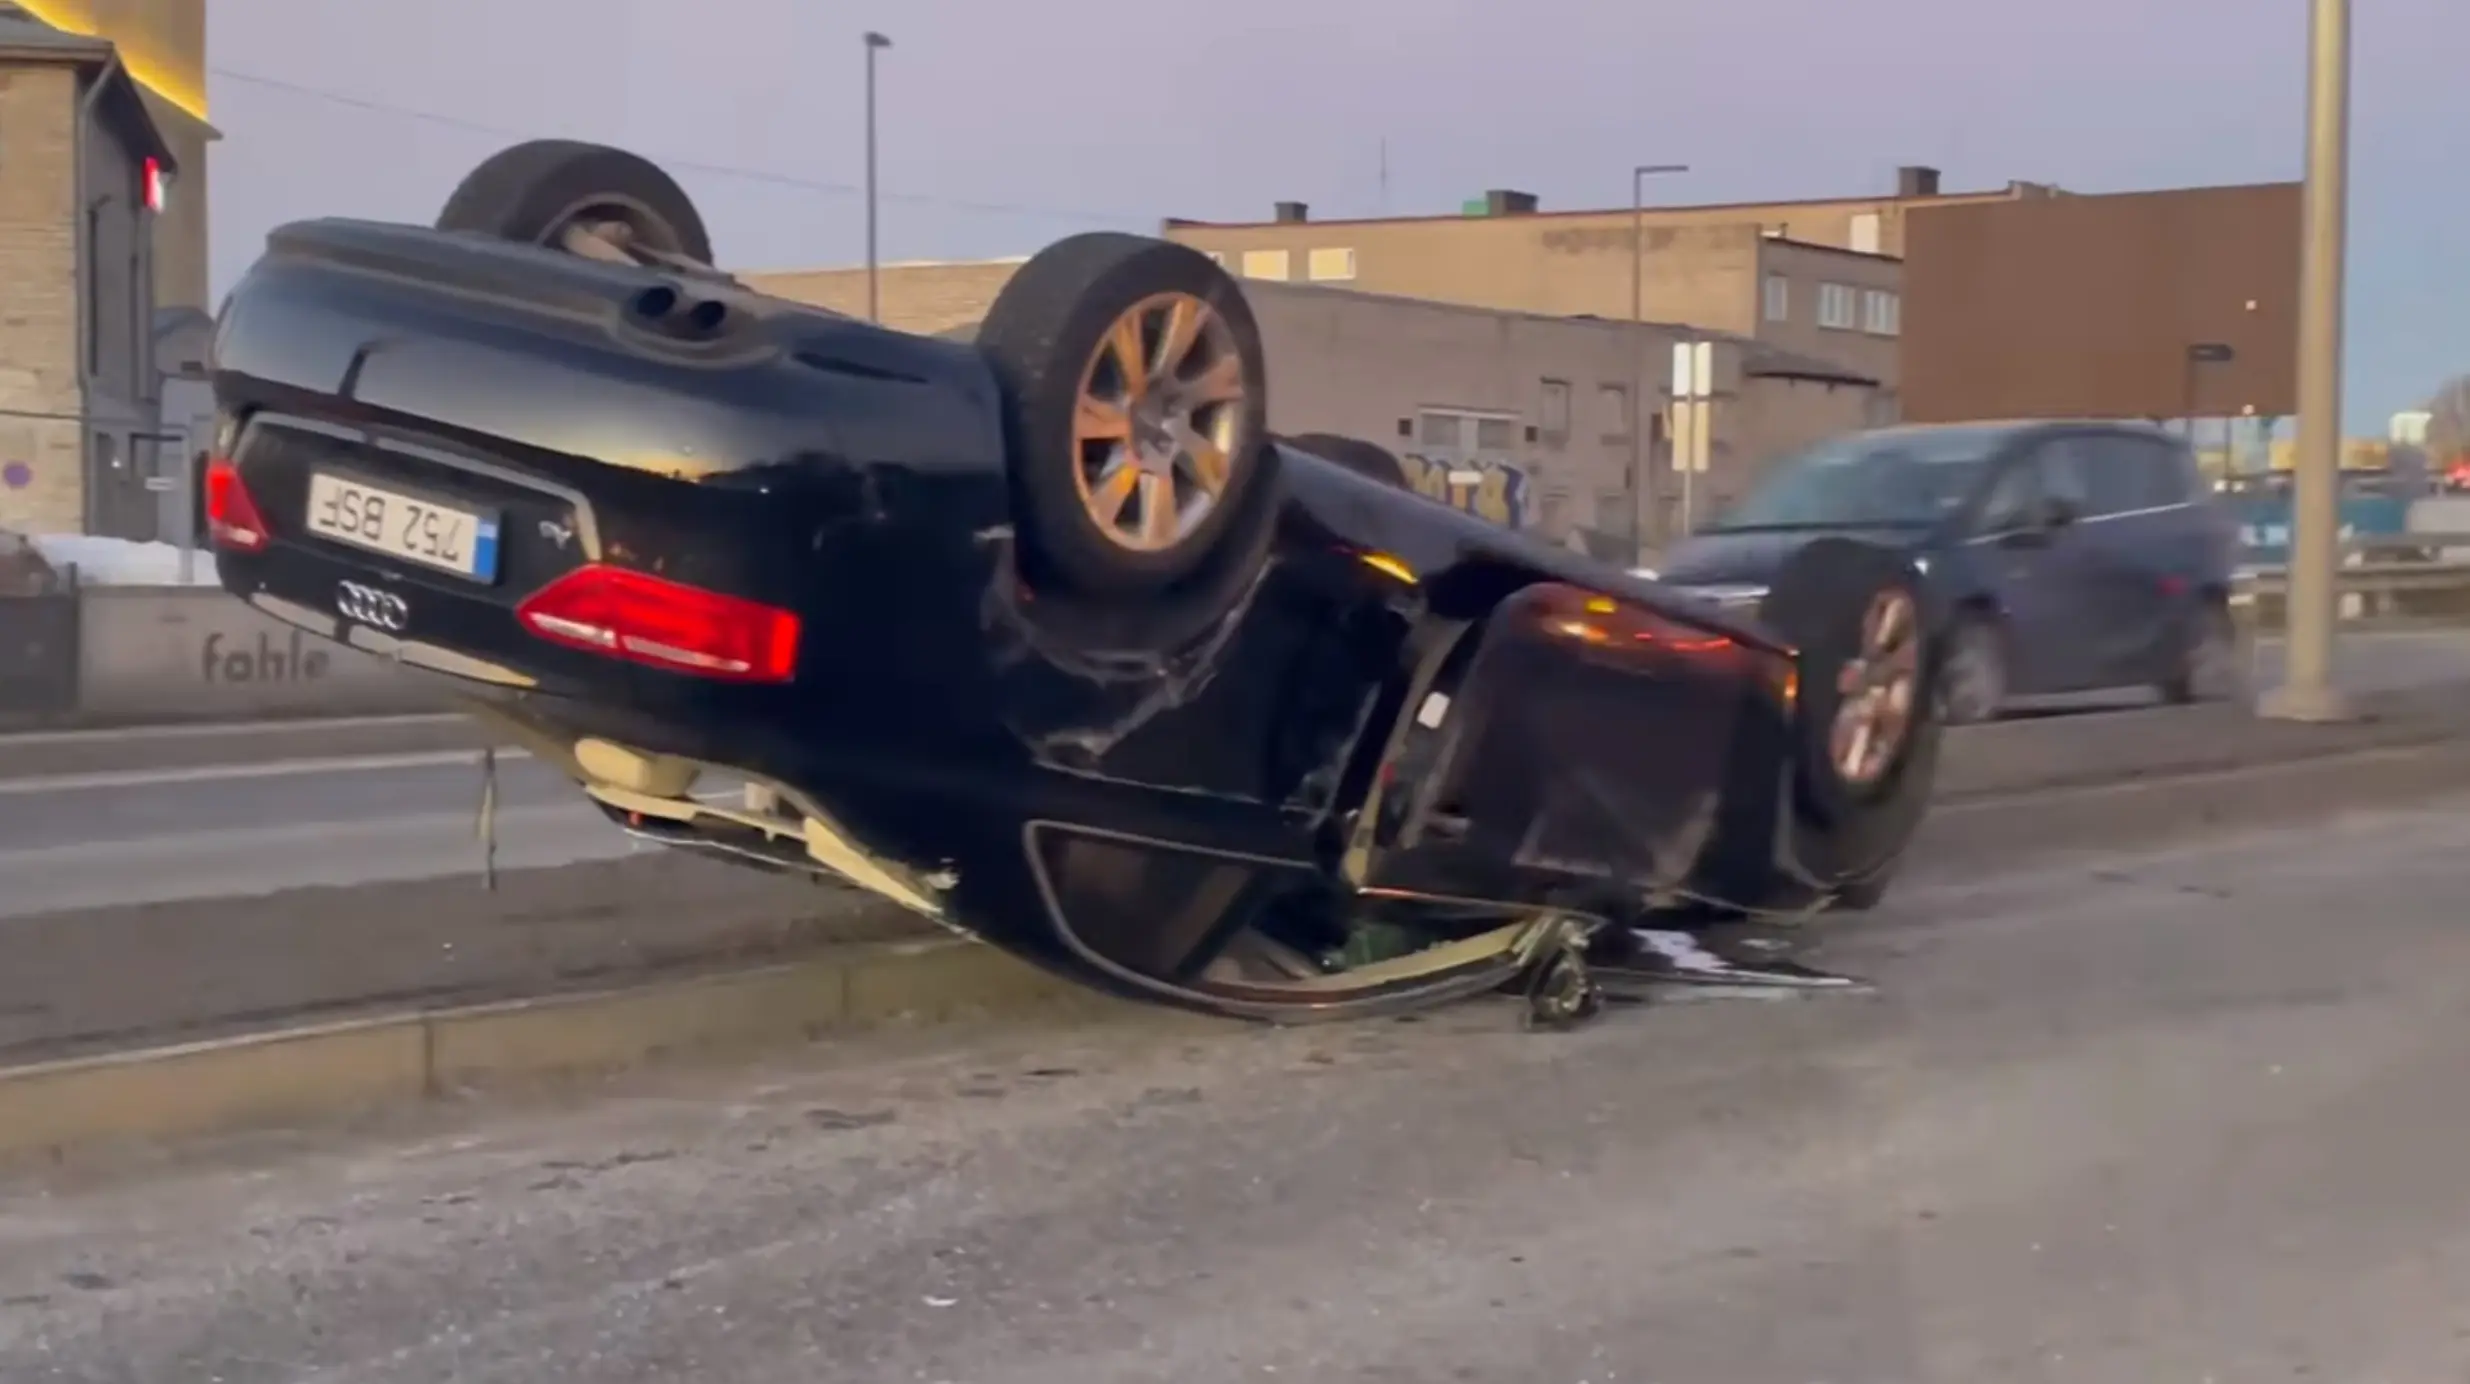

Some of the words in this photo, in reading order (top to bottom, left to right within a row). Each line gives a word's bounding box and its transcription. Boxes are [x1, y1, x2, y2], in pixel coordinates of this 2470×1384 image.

[318, 486, 386, 541] BSF
[402, 505, 461, 561] 752
[204, 630, 330, 683] fahle
